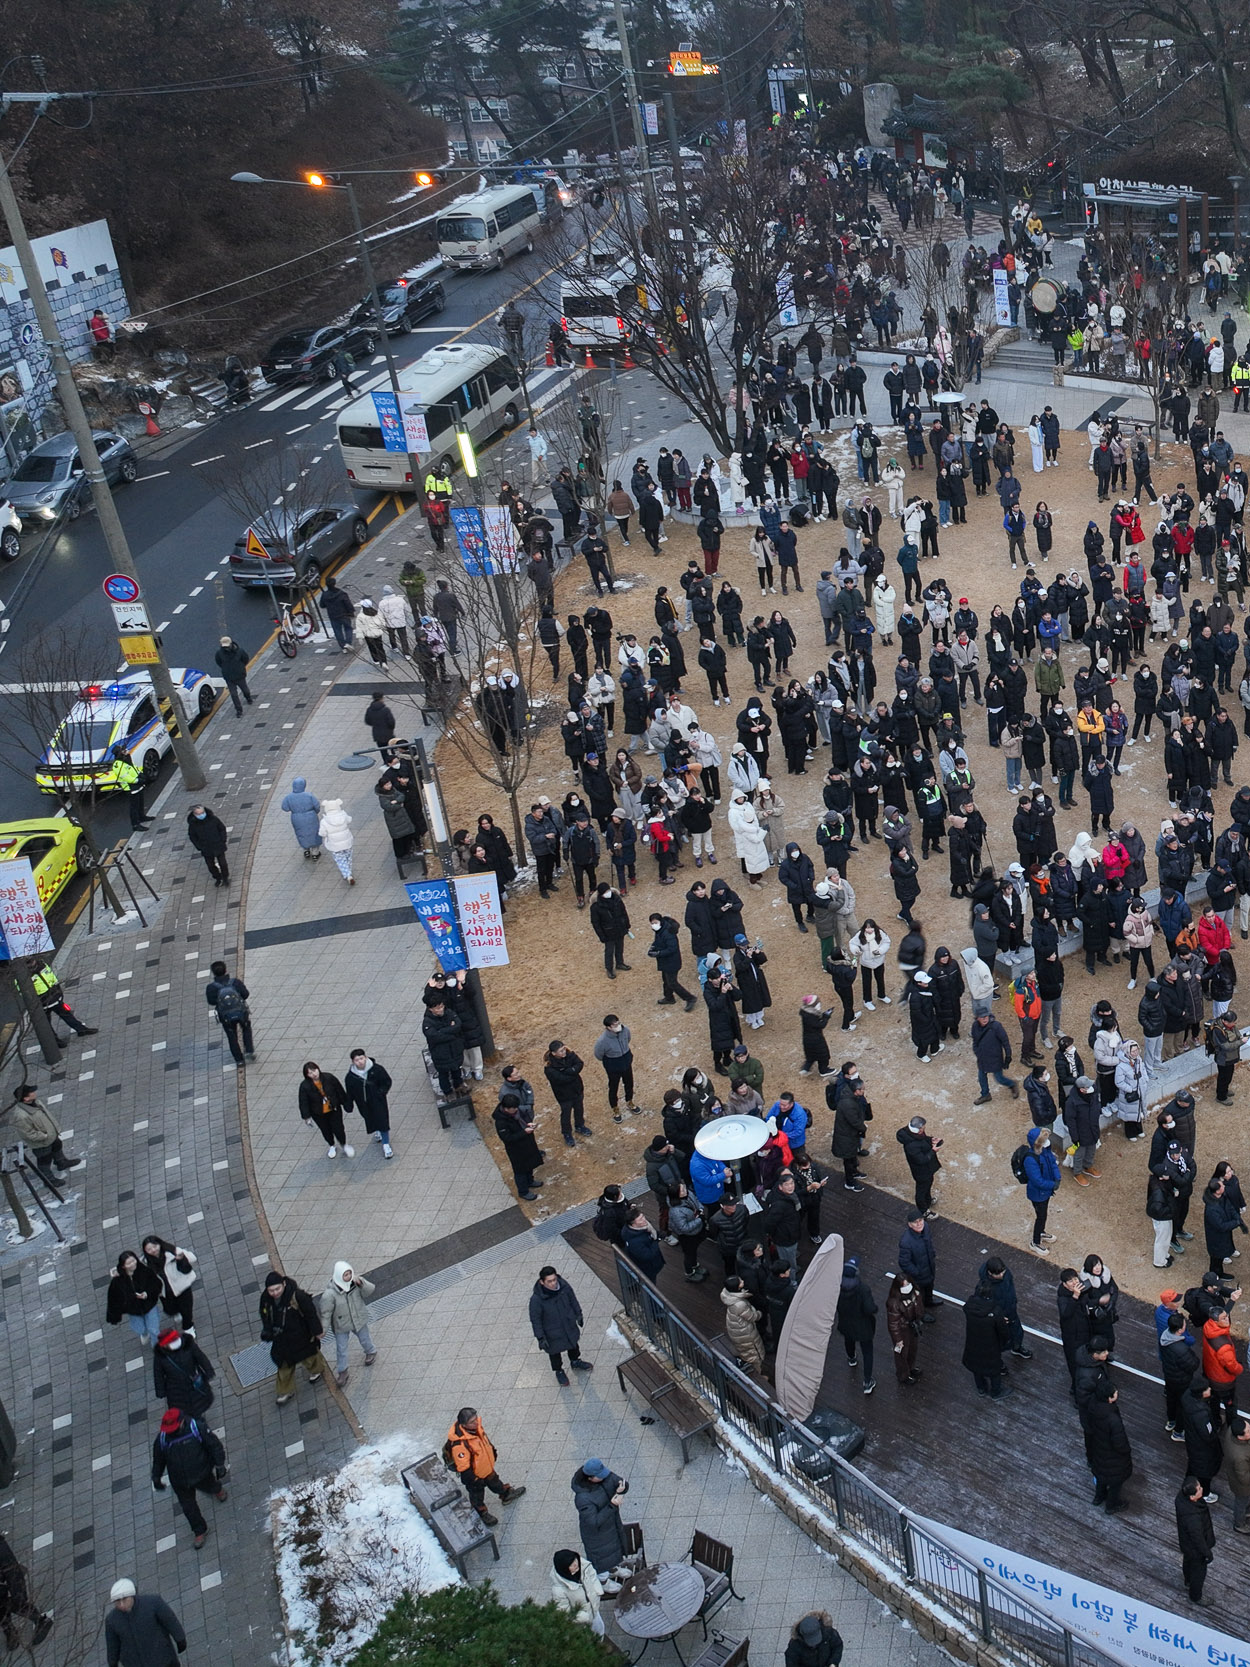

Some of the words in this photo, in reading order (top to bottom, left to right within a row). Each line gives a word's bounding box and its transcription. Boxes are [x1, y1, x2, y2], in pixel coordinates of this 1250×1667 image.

[463, 891, 492, 915] 행복
[4, 911, 44, 924] 새해
[467, 913, 498, 925] 가득한
[465, 925, 502, 937] 새해
[470, 937, 503, 947] 되세요
